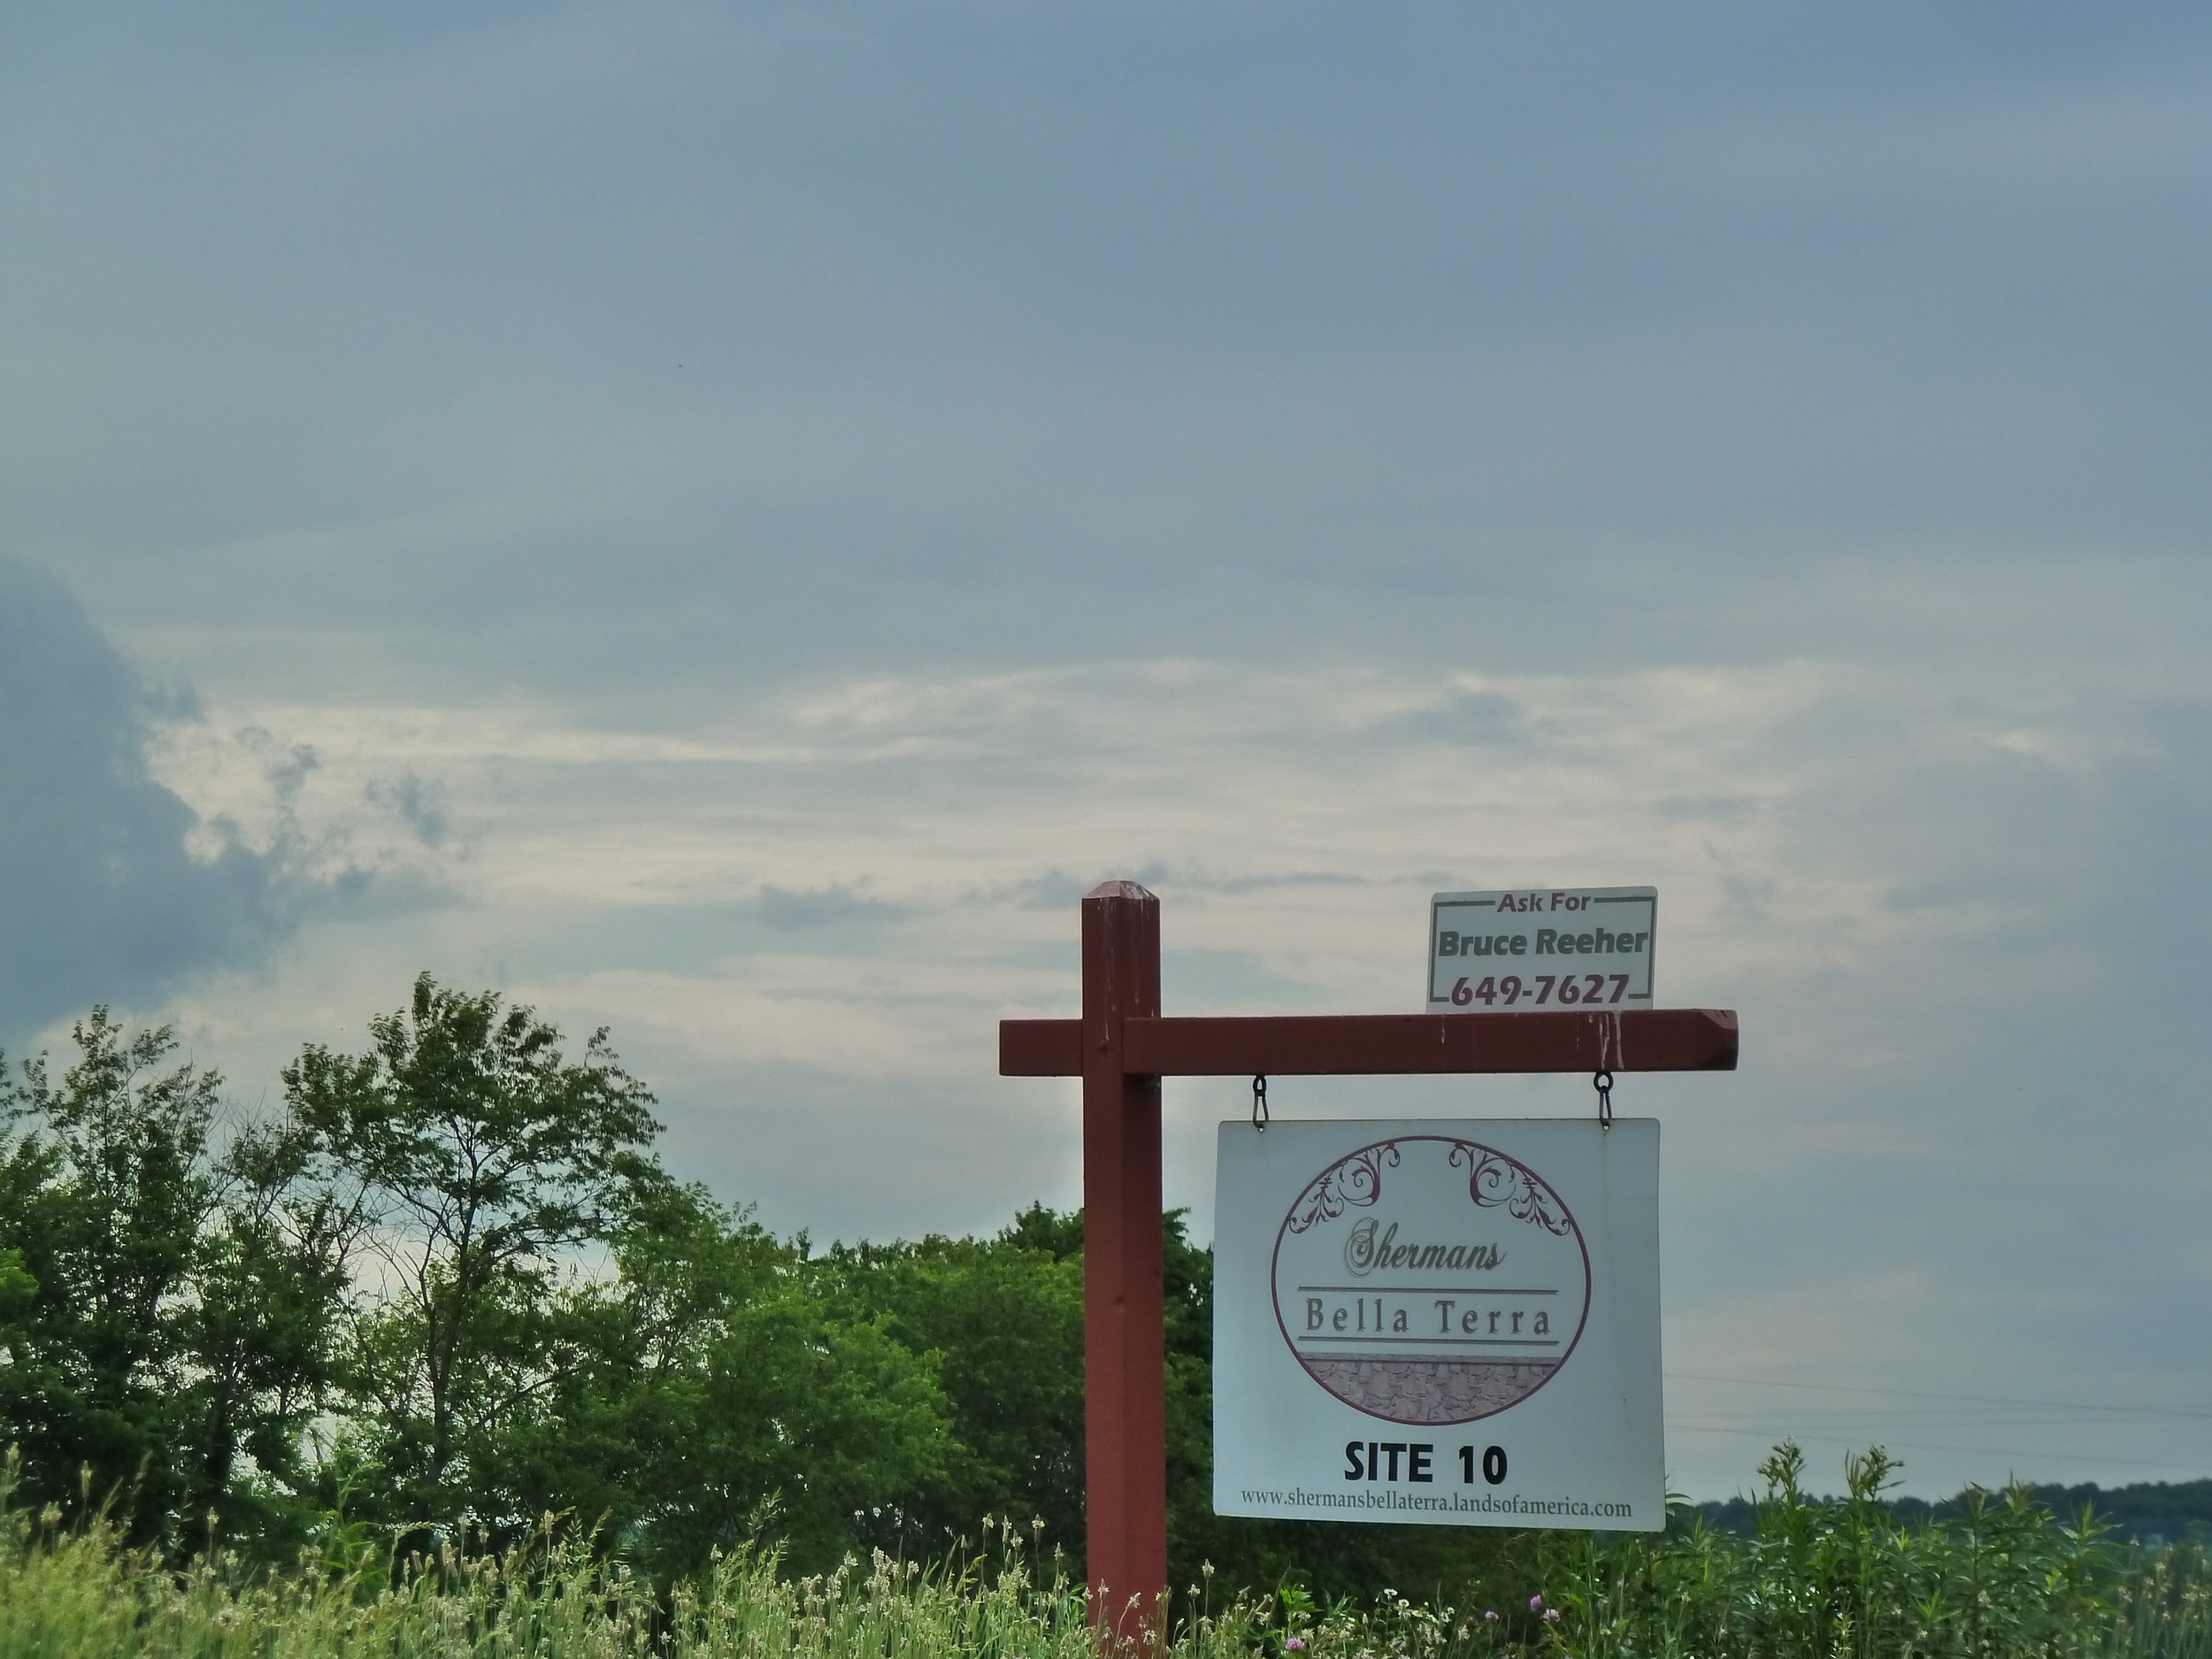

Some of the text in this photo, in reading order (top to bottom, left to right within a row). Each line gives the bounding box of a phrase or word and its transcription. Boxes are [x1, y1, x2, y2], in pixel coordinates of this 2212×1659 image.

[1496, 893, 1591, 912] Ask For
[1438, 928, 1648, 956] Bruce Reeher
[1451, 974, 1630, 1006] 649-7627
[1343, 1217, 1507, 1279] Shermans
[1306, 1297, 1550, 1335] Bella Terra
[1344, 1440, 1509, 1485] SITE 10
[1240, 1487, 1633, 1517] www.shermansbellaterra.landsofamerica.com
